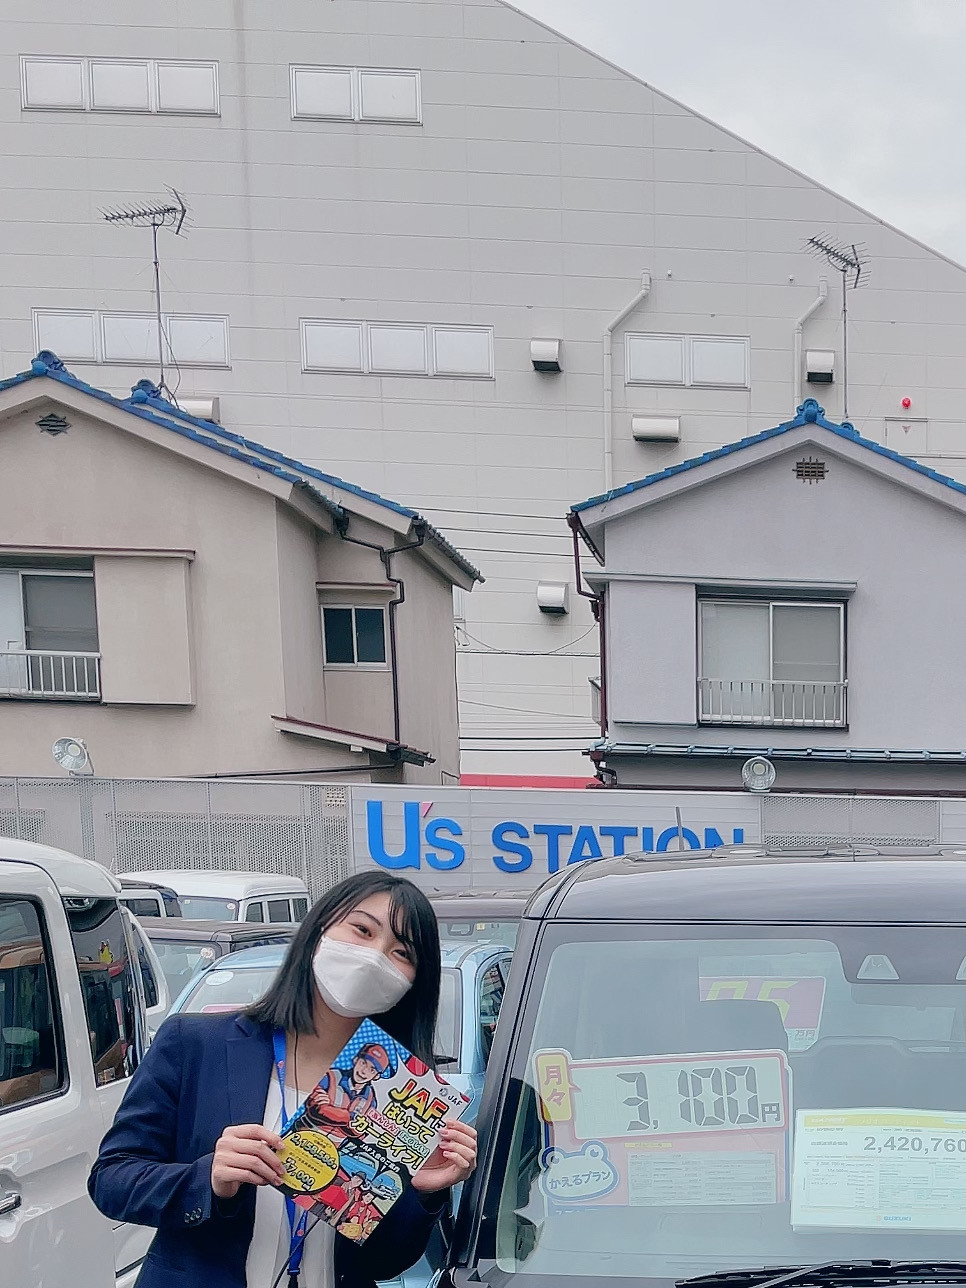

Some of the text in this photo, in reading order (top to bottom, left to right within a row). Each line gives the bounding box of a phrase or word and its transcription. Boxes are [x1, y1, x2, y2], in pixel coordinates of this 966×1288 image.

[549, 1170, 611, 1189] かえるプラン
